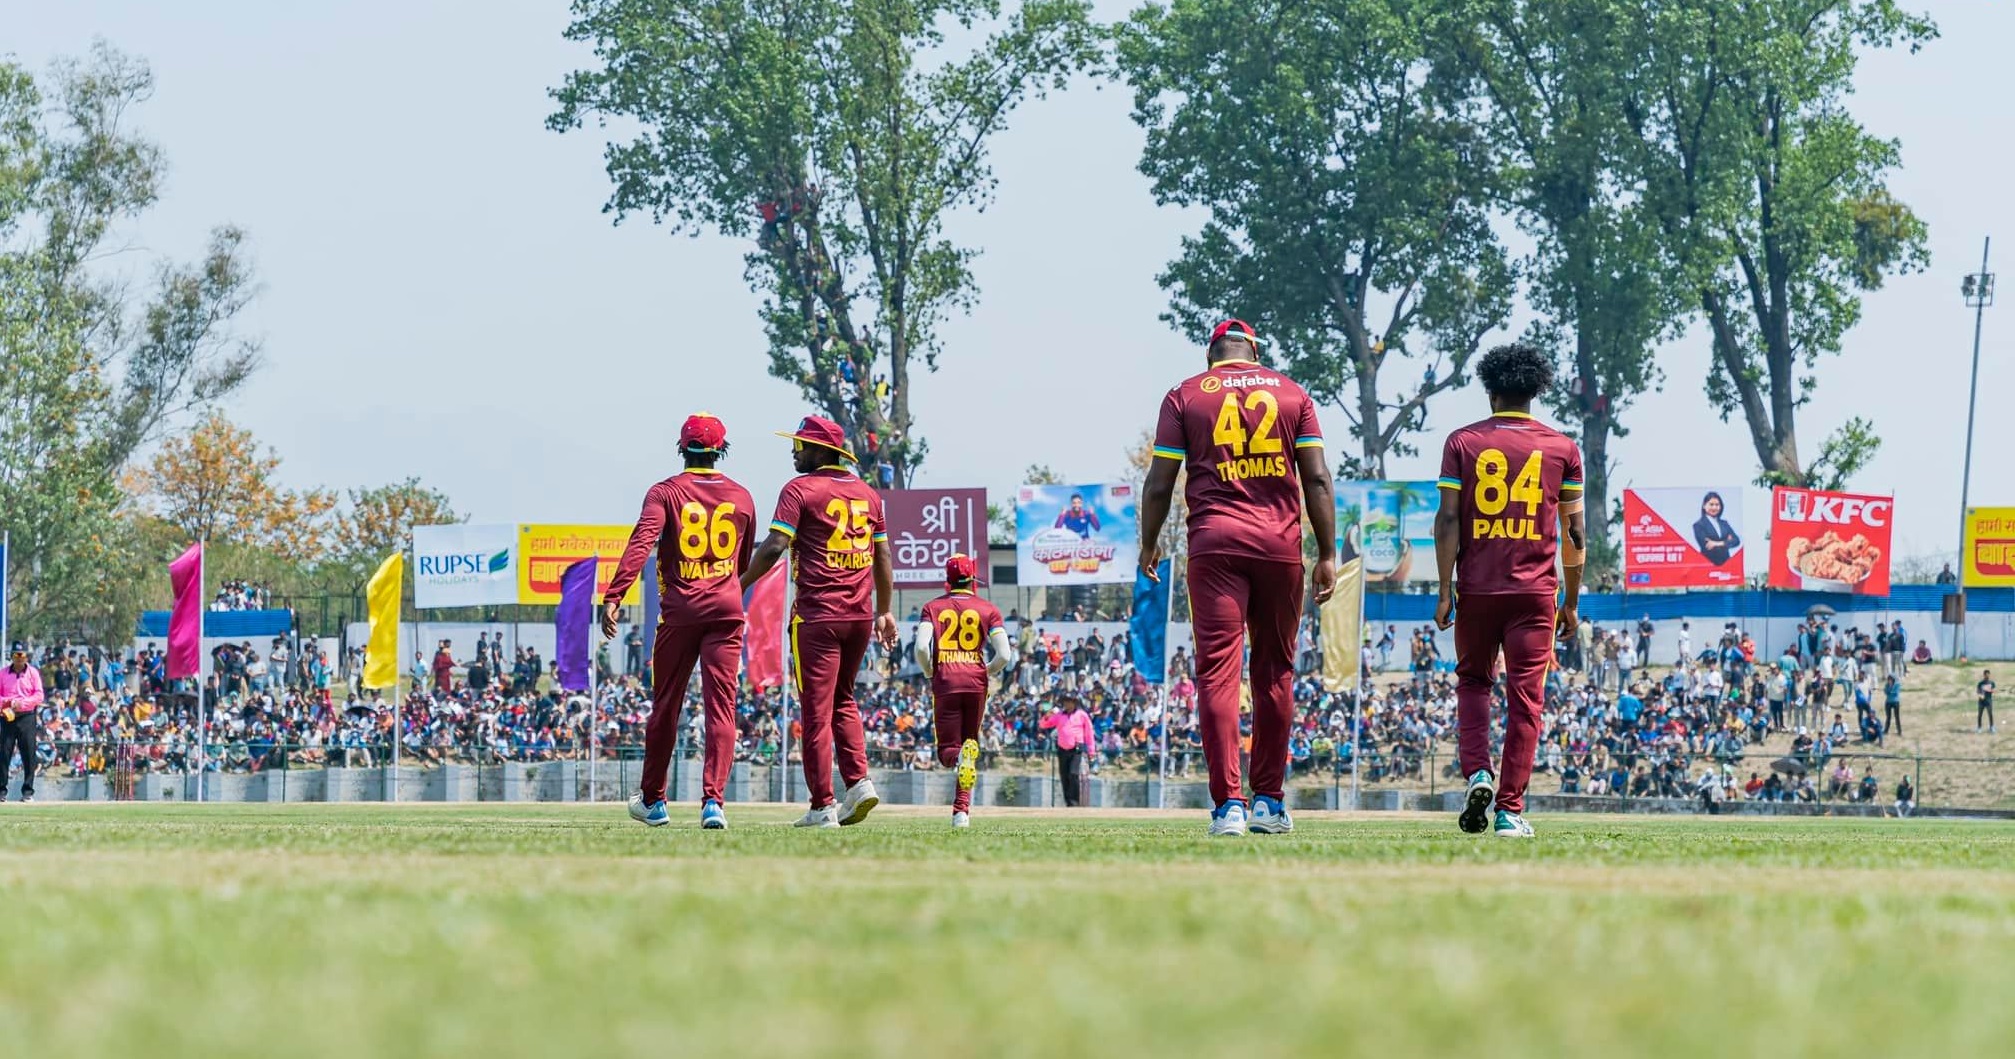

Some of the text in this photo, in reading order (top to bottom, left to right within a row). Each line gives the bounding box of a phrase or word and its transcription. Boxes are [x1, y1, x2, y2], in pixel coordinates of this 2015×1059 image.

[1222, 375, 1281, 389] dafabet
[1213, 389, 1283, 457] 42
[1216, 456, 1287, 482] THOMAS
[1474, 448, 1543, 516] 84
[825, 498, 872, 550] 25
[920, 496, 960, 534] श्री
[1808, 496, 1888, 527] KFC
[679, 501, 737, 560] 86
[1472, 517, 1543, 541] PAUL
[420, 553, 487, 575] RUPSE
[679, 560, 735, 579] WALSH
[826, 550, 874, 569] CHARLES
[429, 575, 479, 586] HOLIDAYS
[938, 609, 980, 650] 28
